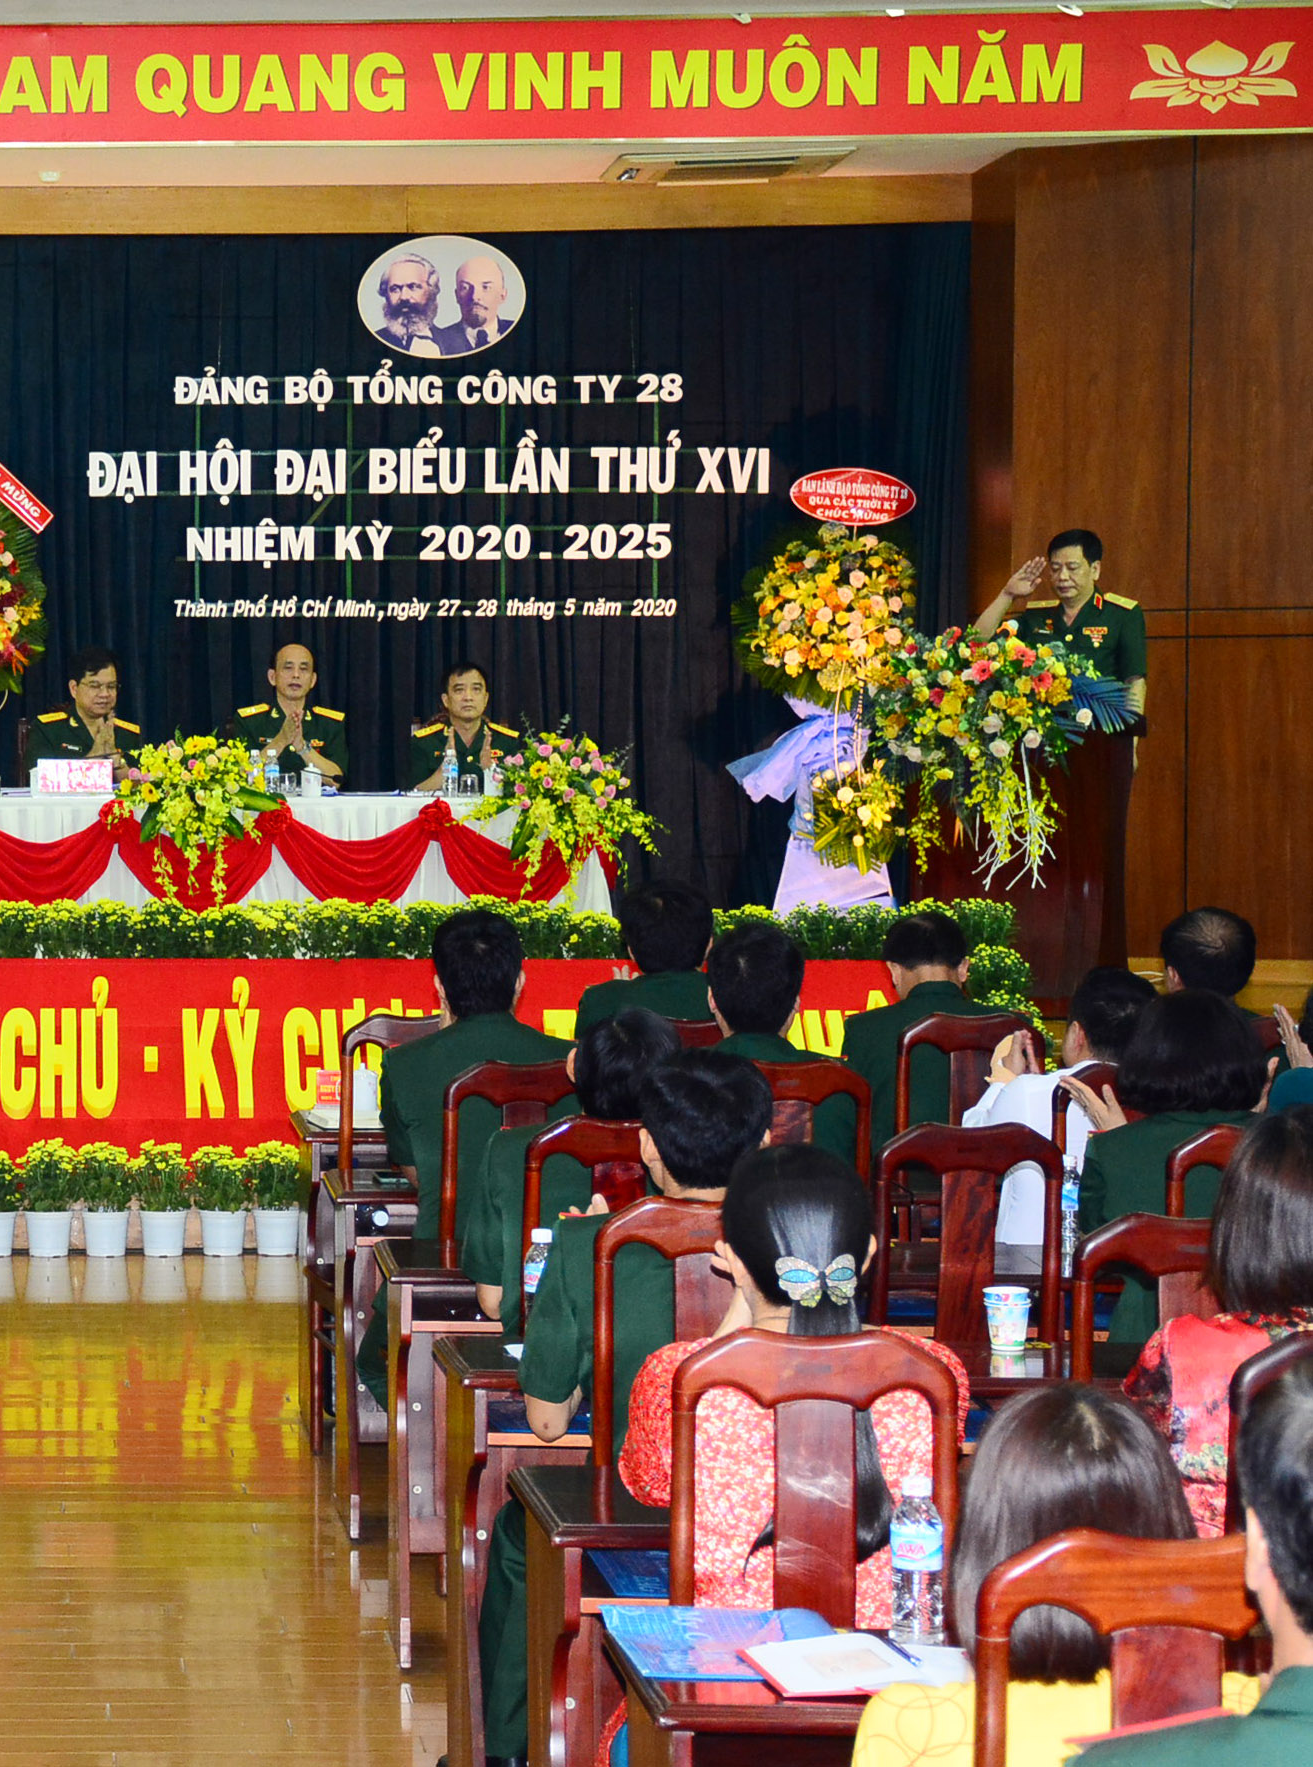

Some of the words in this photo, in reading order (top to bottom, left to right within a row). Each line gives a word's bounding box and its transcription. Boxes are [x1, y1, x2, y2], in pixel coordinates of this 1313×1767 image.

[135, 52, 405, 117] QUANG
[433, 51, 622, 112] VINH
[651, 32, 877, 109] MUÔN
[908, 30, 1082, 105] NĂM
[174, 366, 269, 405] ĐẢNG
[285, 369, 334, 412] BỘ
[347, 359, 443, 405] TỔNG
[458, 370, 556, 405] CÔNG
[574, 375, 621, 404] TY
[637, 373, 683, 403] 28
[87, 450, 157, 504] ĐẠI
[180, 438, 251, 506] HỘI
[274, 449, 346, 502] ĐẠI
[369, 427, 465, 494] BIỂU
[485, 430, 569, 493] LẦN
[591, 430, 681, 493] THỨ
[696, 448, 770, 494] XVI
[1, 481, 41, 517] MỪNG
[809, 495, 831, 506] QUA
[187, 518, 314, 569] NHIỆM
[335, 520, 392, 561] KỲ
[174, 598, 227, 618] Thành
[233, 594, 268, 618] Phố
[271, 595, 298, 618] Hồ
[302, 596, 333, 618] Chí
[387, 597, 431, 622] ngày
[506, 597, 556, 621] tháng
[564, 598, 577, 617] 5
[583, 598, 622, 617] năm
[631, 598, 677, 617] 2020
[0, 976, 119, 1119] CHỦ
[182, 976, 260, 1118] KỶ
